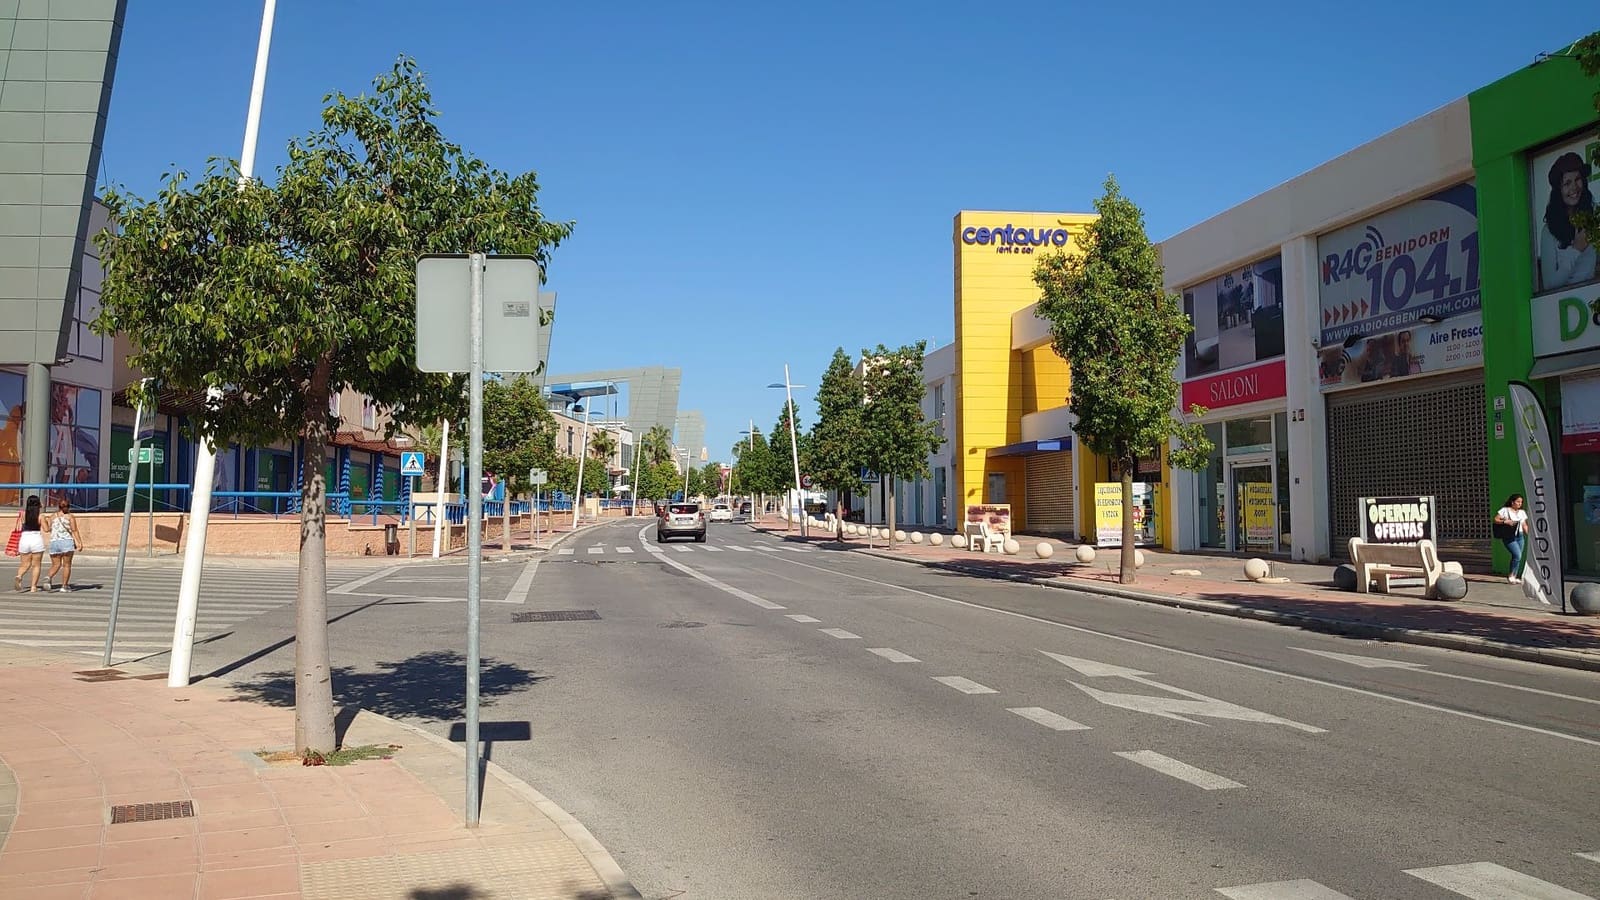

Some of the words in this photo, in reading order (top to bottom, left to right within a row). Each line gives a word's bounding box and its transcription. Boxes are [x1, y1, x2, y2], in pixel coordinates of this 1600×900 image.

[962, 224, 1068, 247] centauro
[1376, 226, 1450, 262] BENIDORM
[1324, 242, 1372, 286] R4G
[1366, 231, 1480, 317] 104.1
[1326, 295, 1480, 342] WWW.RADIO4GBENIDORM.COM
[1429, 331, 1449, 345] Aire
[1210, 373, 1258, 402] SALONI
[1369, 503, 1428, 524] OFERTAS
[1375, 522, 1424, 540] OFERTAS
